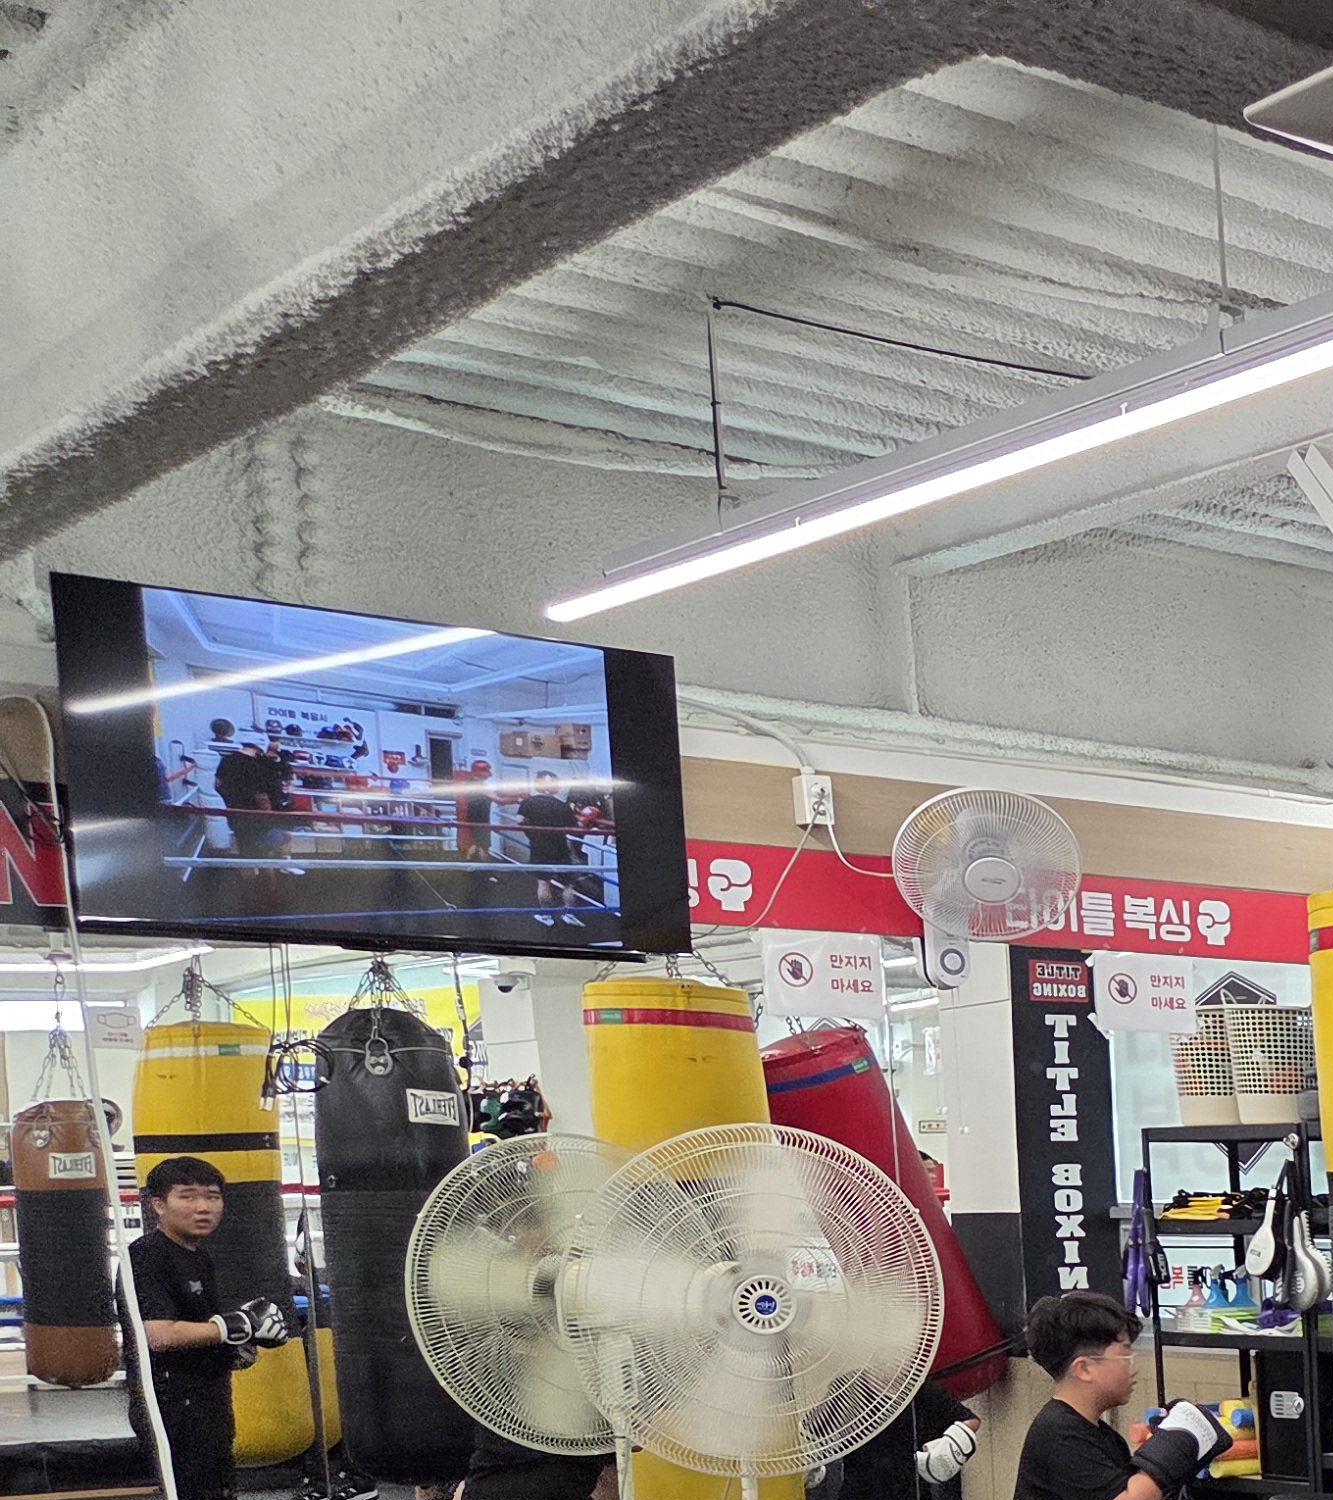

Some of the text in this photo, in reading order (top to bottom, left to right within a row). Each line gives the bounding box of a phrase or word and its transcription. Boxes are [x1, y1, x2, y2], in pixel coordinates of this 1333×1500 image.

[1005, 887, 1192, 942] 타이틀 복싱
[829, 953, 873, 971] 만지지
[831, 978, 874, 994] 마세요
[1149, 974, 1186, 989] 만지지
[1150, 995, 1187, 1010] 마세요
